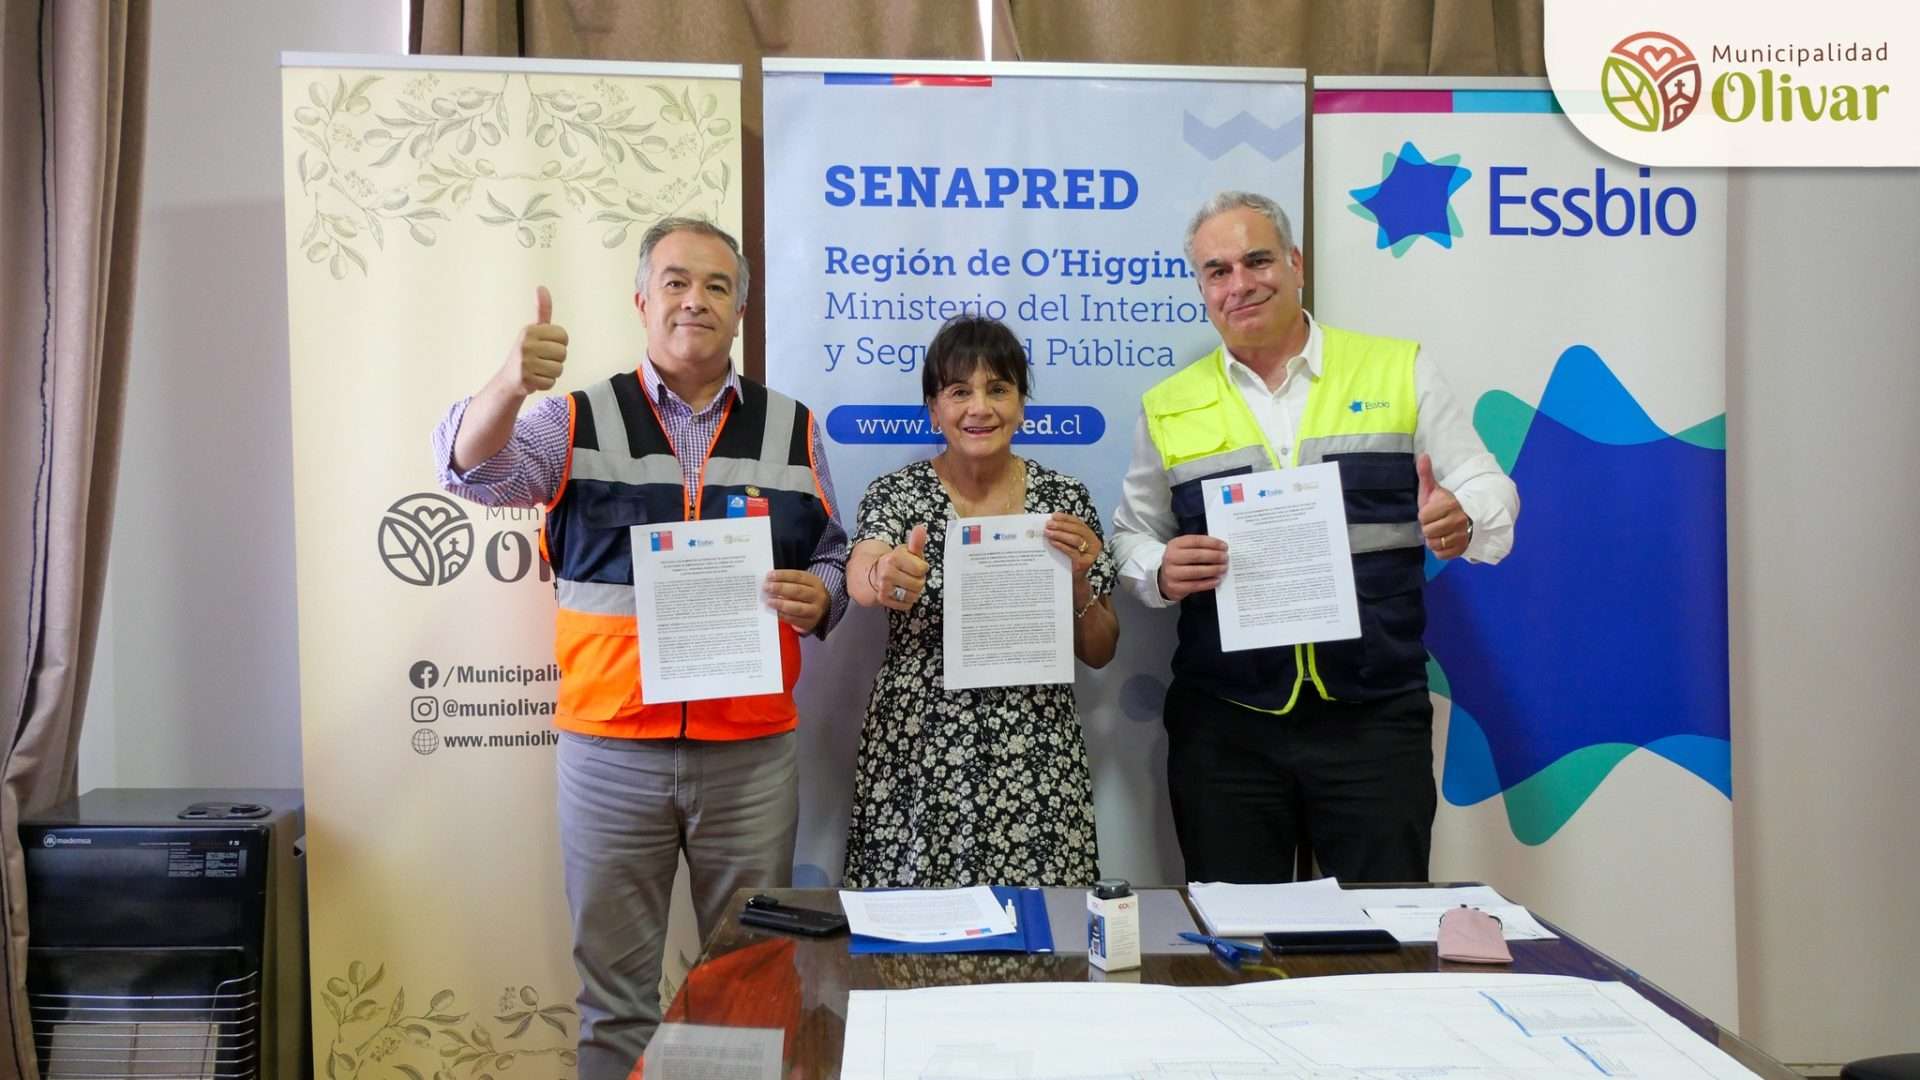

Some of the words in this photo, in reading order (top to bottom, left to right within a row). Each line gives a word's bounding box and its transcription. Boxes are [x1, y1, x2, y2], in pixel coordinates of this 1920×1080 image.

[824, 164, 1139, 210] SENAPRED
[1489, 166, 1698, 238] Essbio
[825, 246, 956, 283] Región
[967, 248, 1010, 277] de
[1021, 248, 1195, 286] O'Higgin
[824, 291, 1007, 322] Ministerio
[1017, 294, 1069, 322] del
[823, 343, 846, 373] y
[1046, 338, 1174, 368] Pública
